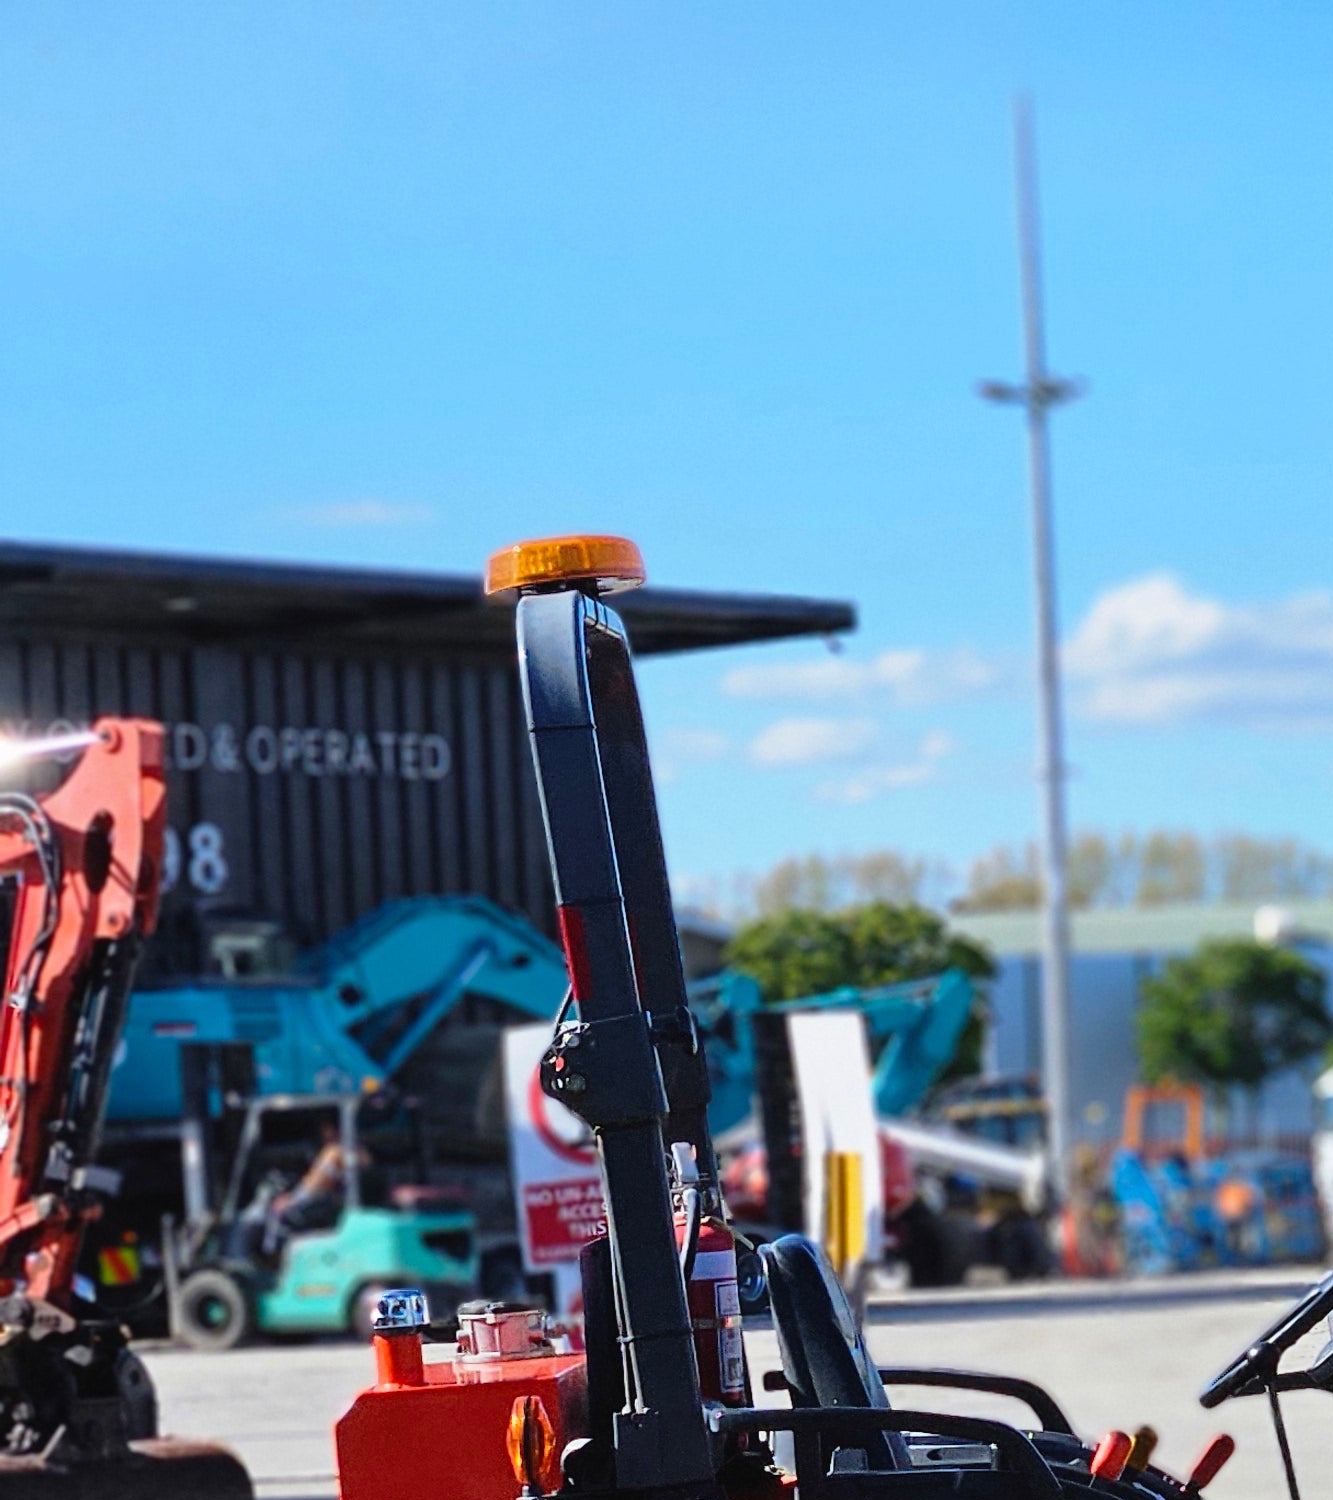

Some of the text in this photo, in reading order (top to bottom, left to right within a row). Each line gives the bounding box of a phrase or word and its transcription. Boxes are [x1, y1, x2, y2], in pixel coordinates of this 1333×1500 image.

[246, 724, 451, 780] OPERATED
[525, 1189, 553, 1206] NO
[568, 1220, 607, 1238] THIS
